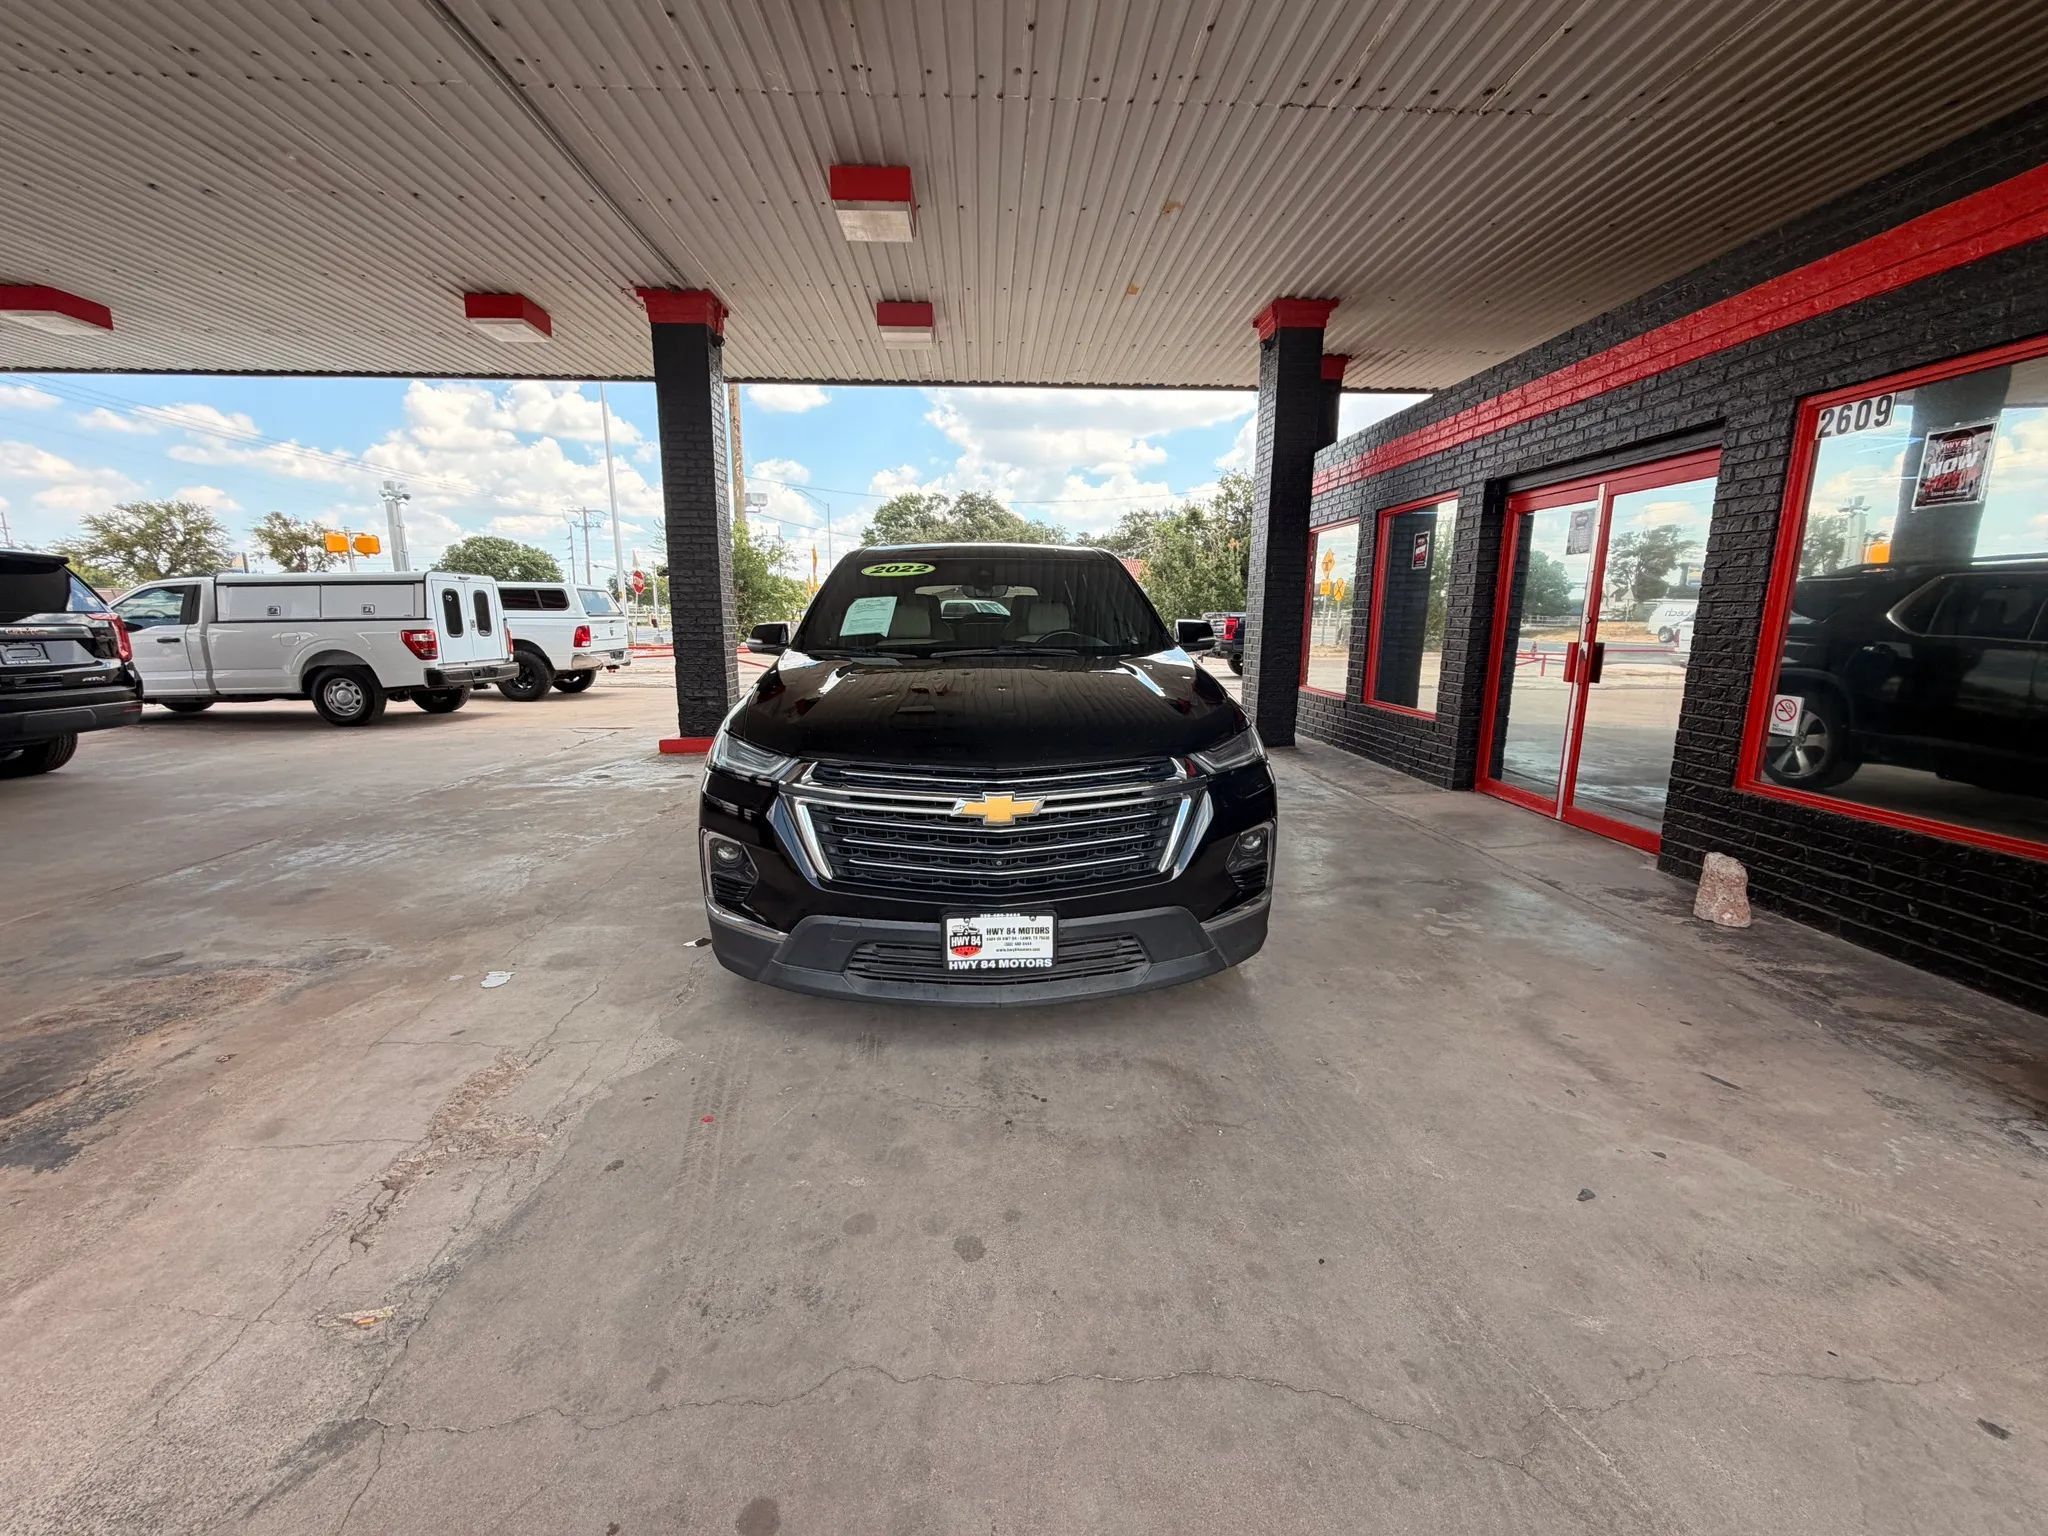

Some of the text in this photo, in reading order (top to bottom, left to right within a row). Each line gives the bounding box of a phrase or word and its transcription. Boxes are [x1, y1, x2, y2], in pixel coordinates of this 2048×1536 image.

[1817, 395, 1893, 438] 2609
[1926, 450, 1981, 479] NOW
[869, 565, 930, 574] 2022
[986, 926, 1050, 936] HWY 84 MOTORS
[951, 936, 970, 947] HWY
[970, 935, 982, 946] 84
[948, 958, 1053, 970] HWY 84 MOTORS
